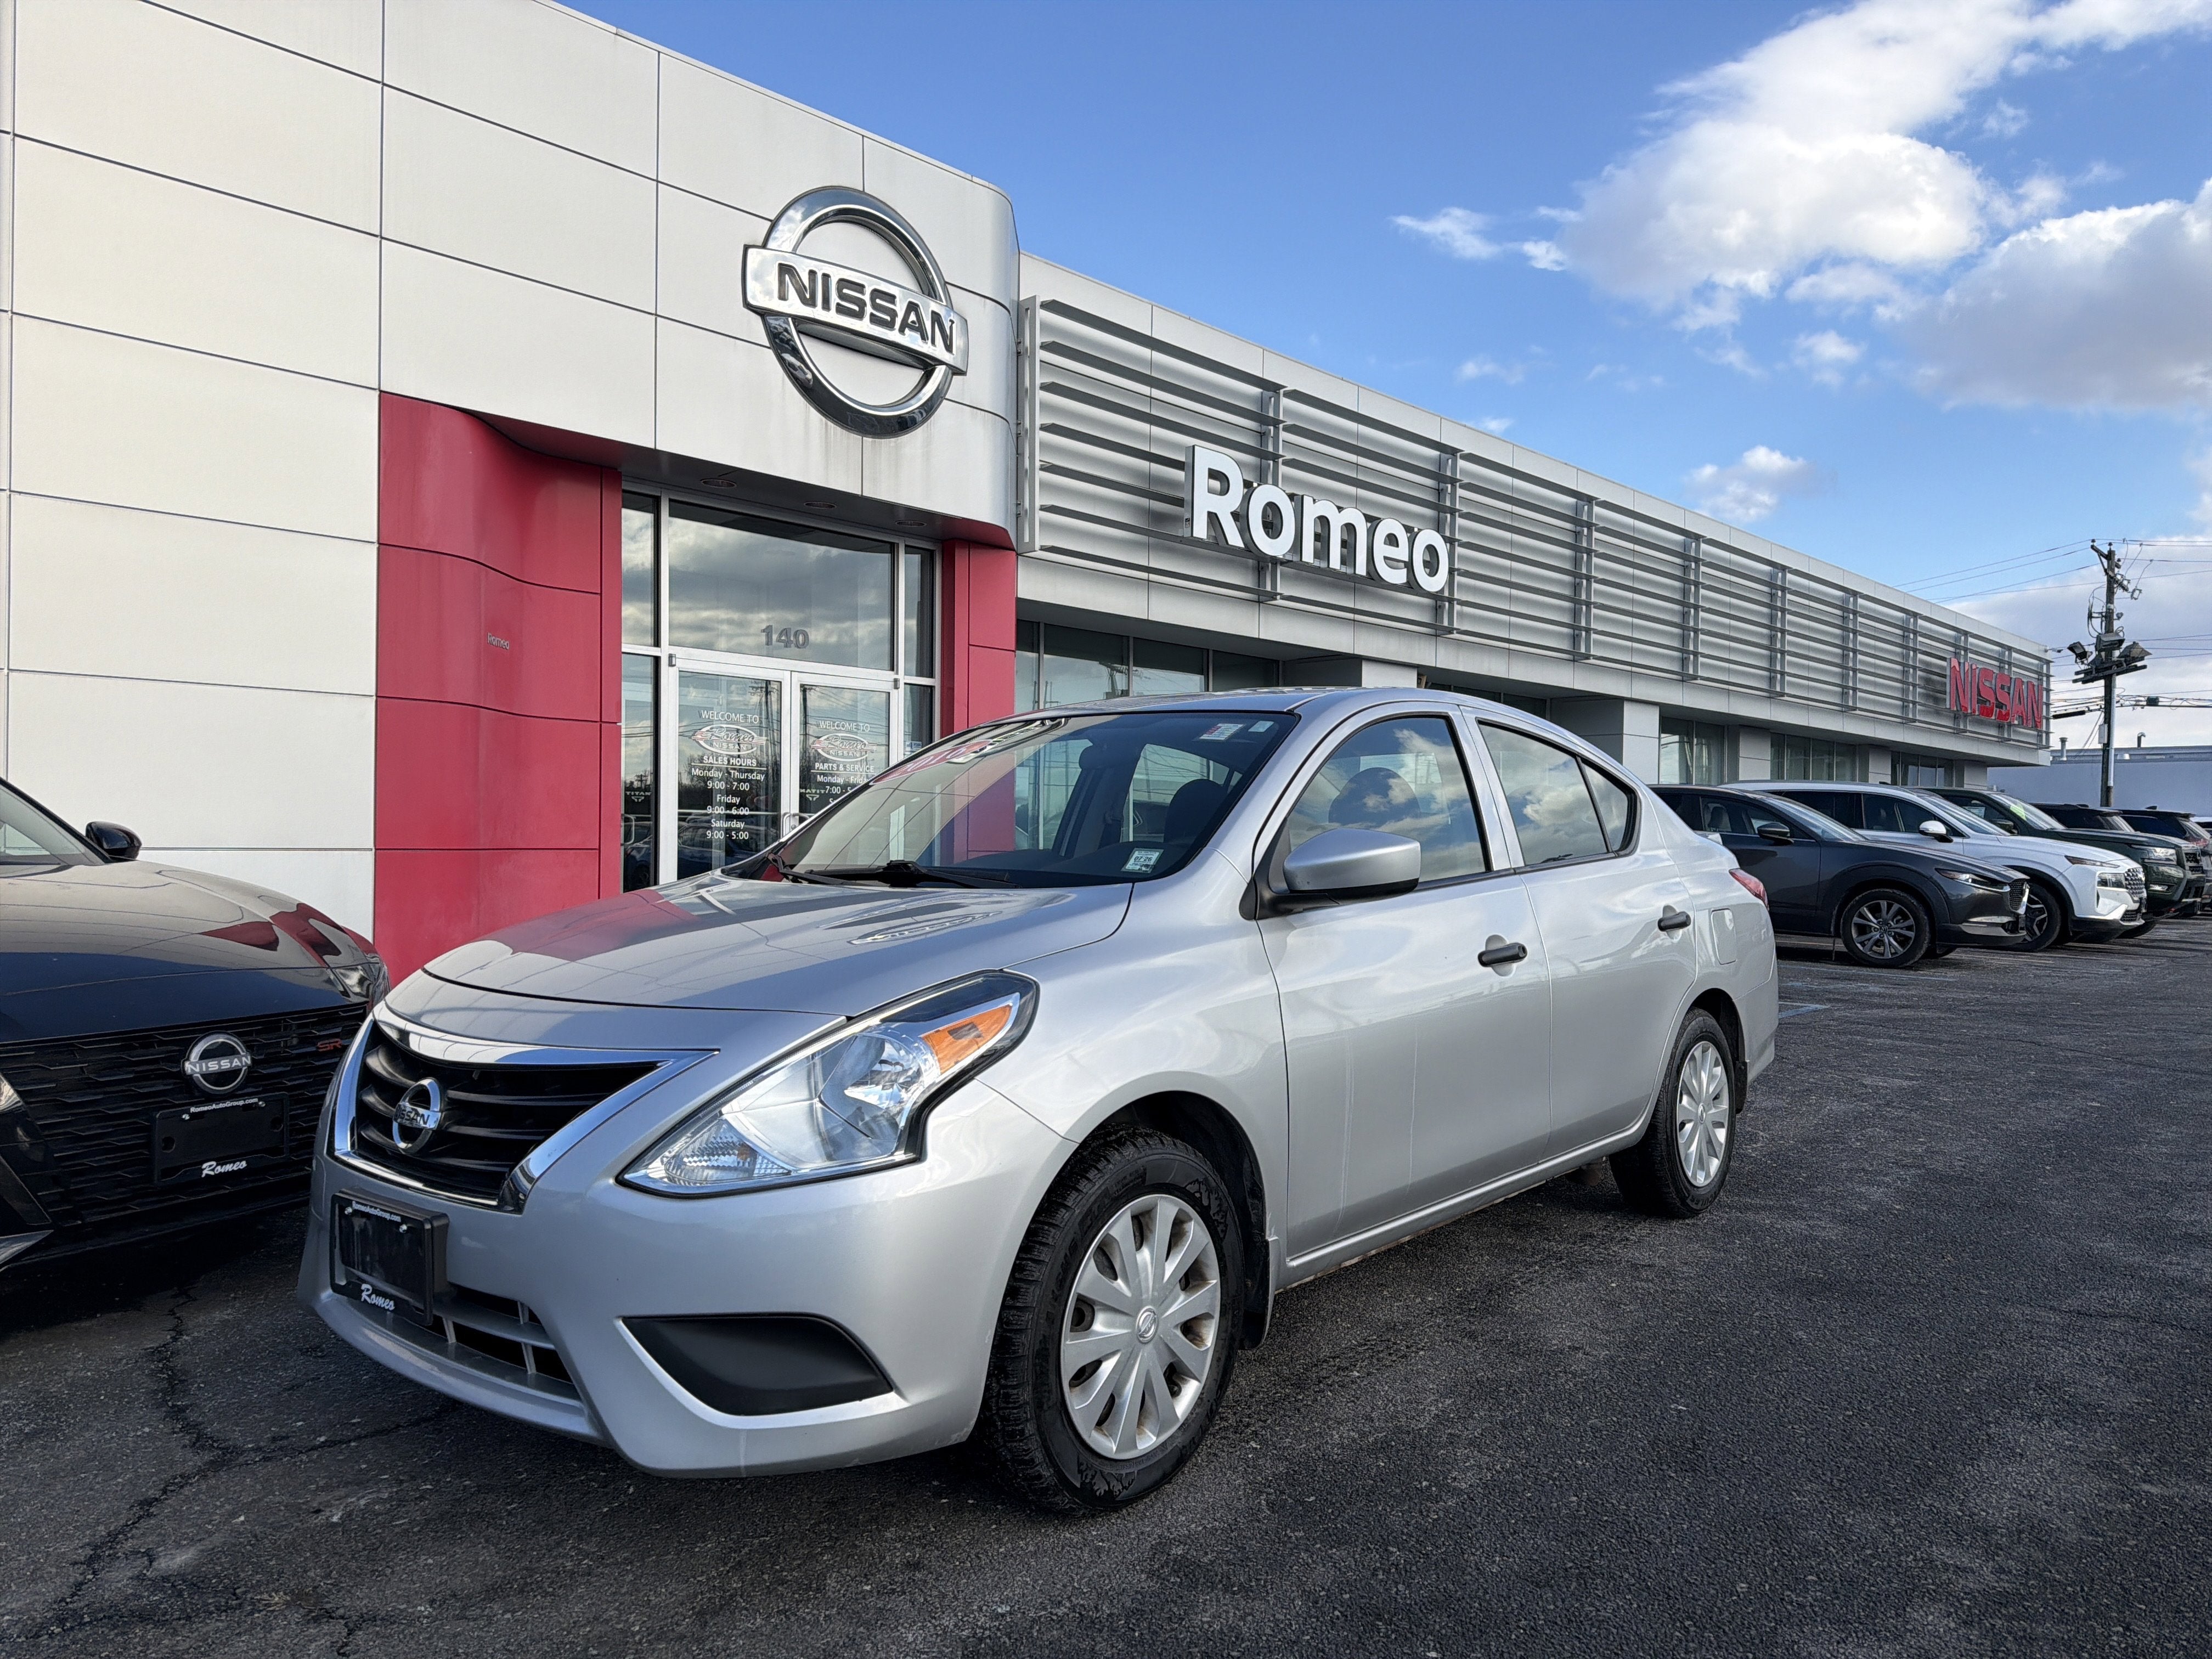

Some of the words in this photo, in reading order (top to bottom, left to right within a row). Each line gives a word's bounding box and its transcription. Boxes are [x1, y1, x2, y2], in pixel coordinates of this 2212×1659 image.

[777, 262, 955, 356] NISSAN
[1184, 444, 1449, 592] Romeo
[487, 632, 510, 650] Romeo
[761, 625, 809, 648] 140
[1947, 657, 2043, 729] NISSAN
[701, 710, 744, 722] WELCOME
[747, 714, 759, 724] TO
[819, 720, 856, 731] WELCOME
[860, 724, 870, 732] TO
[709, 725, 755, 743] Romeo
[826, 735, 866, 751] Romeo
[703, 755, 728, 764] SALES
[730, 758, 757, 766] HOURS
[691, 768, 723, 778] Monday
[730, 770, 765, 782] Thursday
[846, 764, 874, 772] SERVICE
[707, 781, 725, 789] 9:00
[732, 782, 750, 791] 7:00
[817, 775, 845, 785] Monday
[850, 775, 869, 784] Frida
[716, 794, 741, 805] Friday
[707, 806, 725, 814] 9:00
[732, 807, 749, 815] 6:00
[711, 819, 745, 829] Saturday
[706, 831, 724, 839] 9:00
[317, 1039, 342, 1052] SR
[188, 1056, 251, 1073] NISSAN
[190, 1098, 258, 1113] RomeoAutoGroup.com
[201, 1160, 247, 1178] Romeo
[360, 1283, 396, 1311] Romeo
